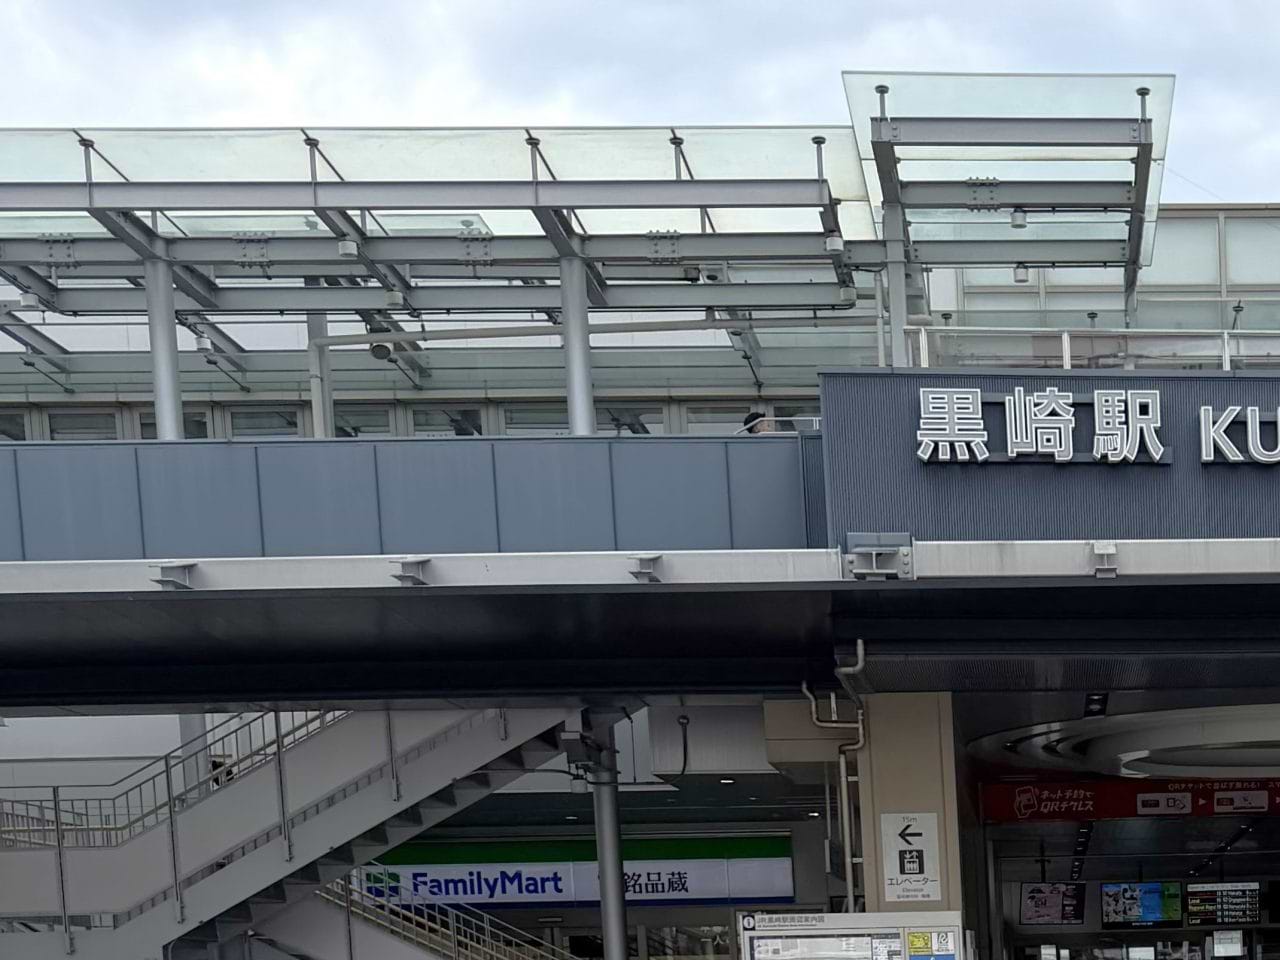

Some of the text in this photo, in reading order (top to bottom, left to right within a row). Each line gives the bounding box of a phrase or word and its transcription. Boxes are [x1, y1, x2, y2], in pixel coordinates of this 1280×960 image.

[916, 385, 1166, 464] 黒崎駅
[412, 870, 564, 898] FamilyMart
[887, 876, 939, 886] エレベーター
